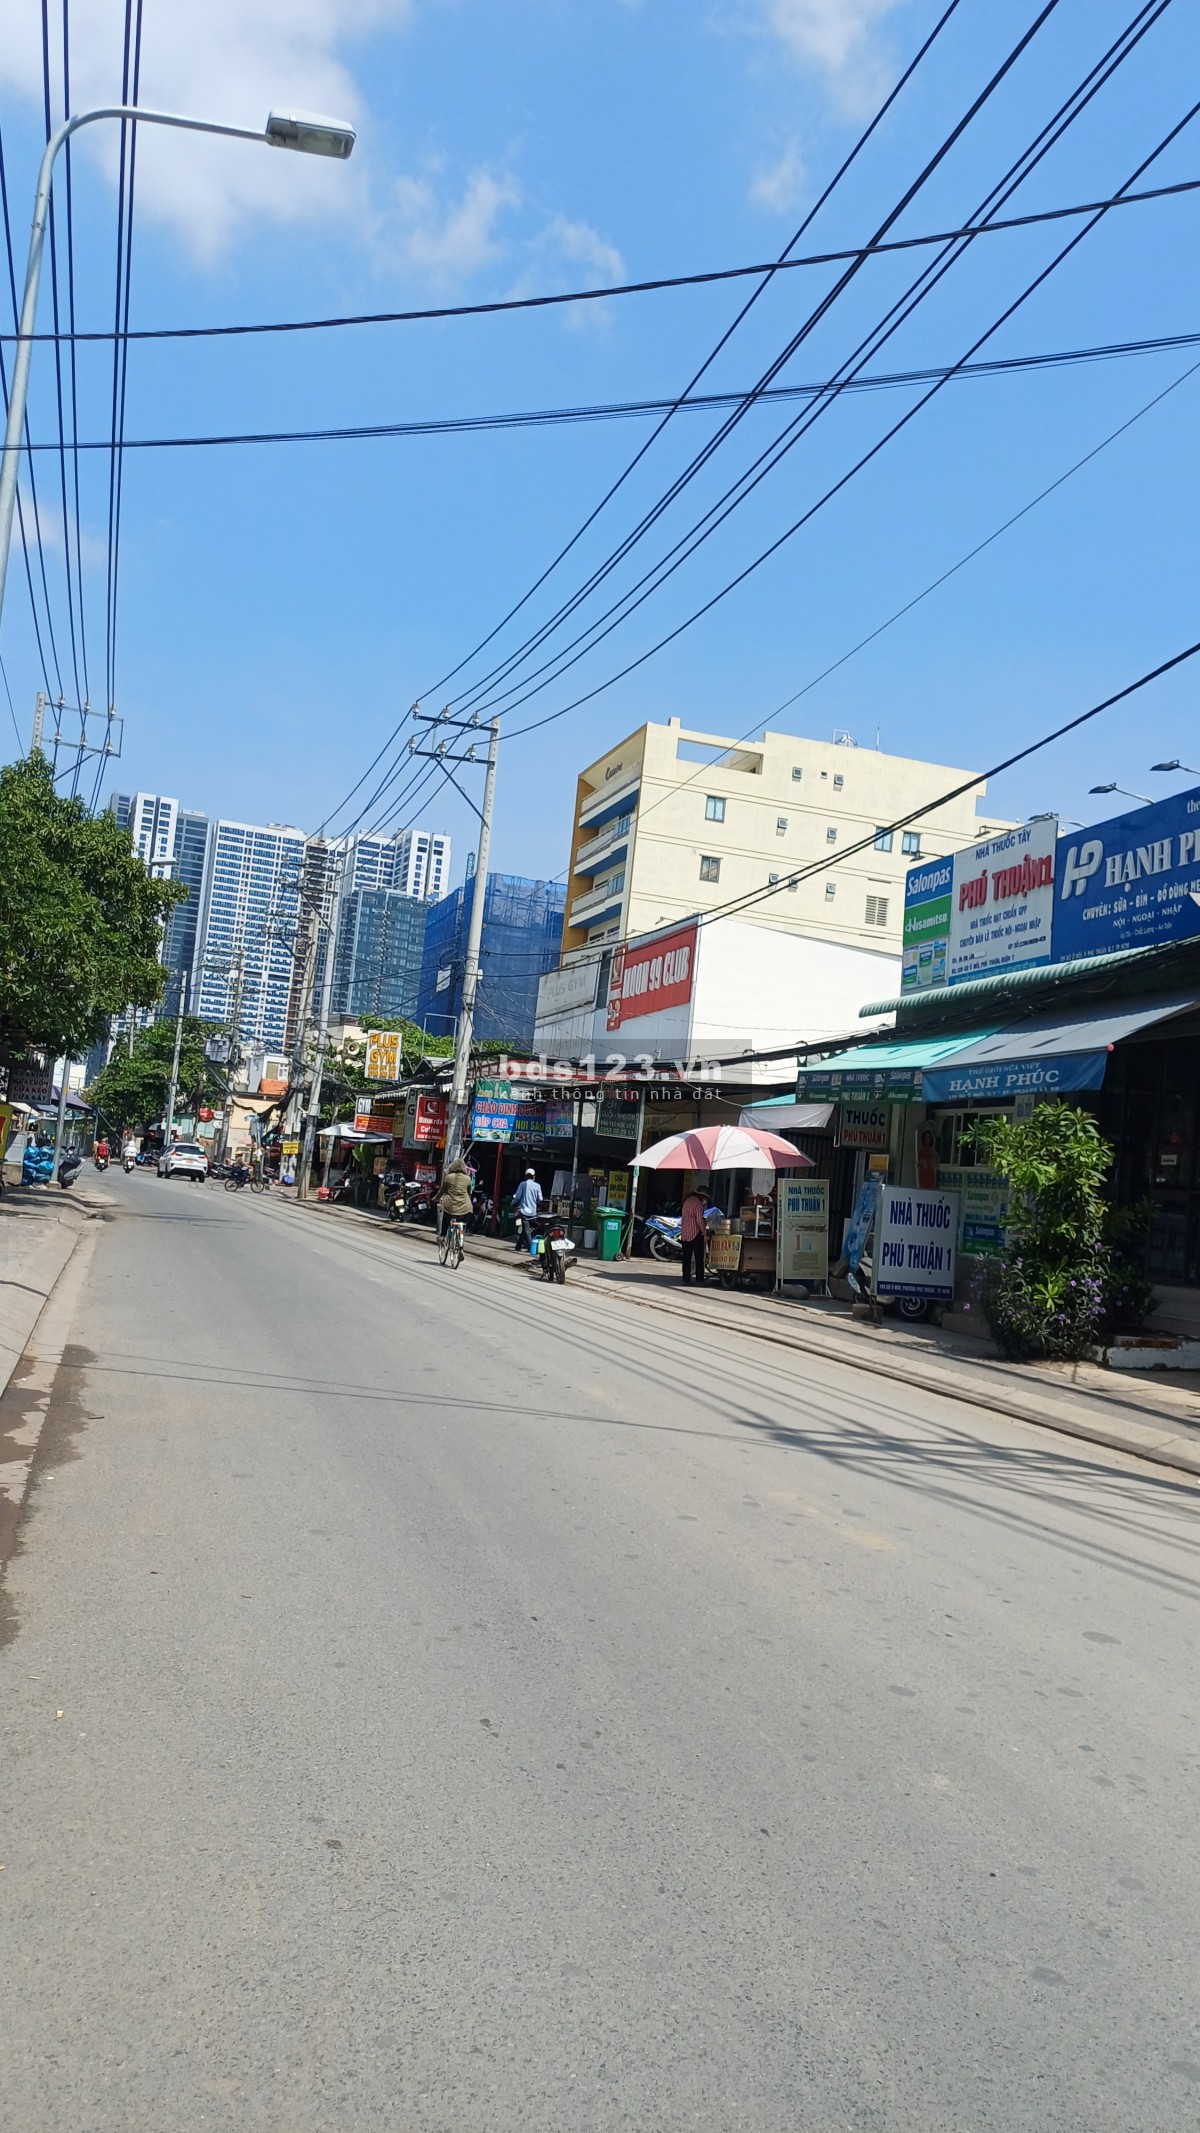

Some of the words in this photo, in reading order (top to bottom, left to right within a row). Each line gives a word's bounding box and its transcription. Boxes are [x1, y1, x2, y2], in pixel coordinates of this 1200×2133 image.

[975, 845, 990, 861] NHÀ
[992, 833, 1016, 853] THUỐC
[1018, 829, 1032, 845] TÂY
[1061, 839, 1104, 900] HP
[1104, 837, 1173, 893] HẠNH
[906, 867, 951, 897] Salonpas
[959, 869, 988, 912] PHÚ
[905, 912, 948, 933] Hisamitsu
[568, 975, 586, 992] GYM
[622, 960, 650, 999] MOON
[649, 956, 662, 991] 99
[662, 946, 691, 987] CLUB
[369, 1033, 399, 1048] PLUS
[370, 1048, 397, 1064] GYM
[949, 1076, 1000, 1093] HẠNH
[1005, 1068, 1060, 1087] PHÚC
[357, 1098, 372, 1114] GYM
[846, 1107, 886, 1127] THUỐC
[530, 1121, 545, 1131] SAO
[788, 1185, 802, 1195] NHÀ
[804, 1185, 825, 1195] THUỐC
[788, 1197, 801, 1212] PHÚ
[801, 1198, 821, 1213] THUẬN
[822, 1198, 826, 1212] 1
[890, 1196, 913, 1225] NHÀ
[916, 1196, 951, 1229] THUỐC
[882, 1238, 905, 1267] PHÚ
[908, 1241, 944, 1275] THUẬN
[947, 1248, 952, 1271] 1
